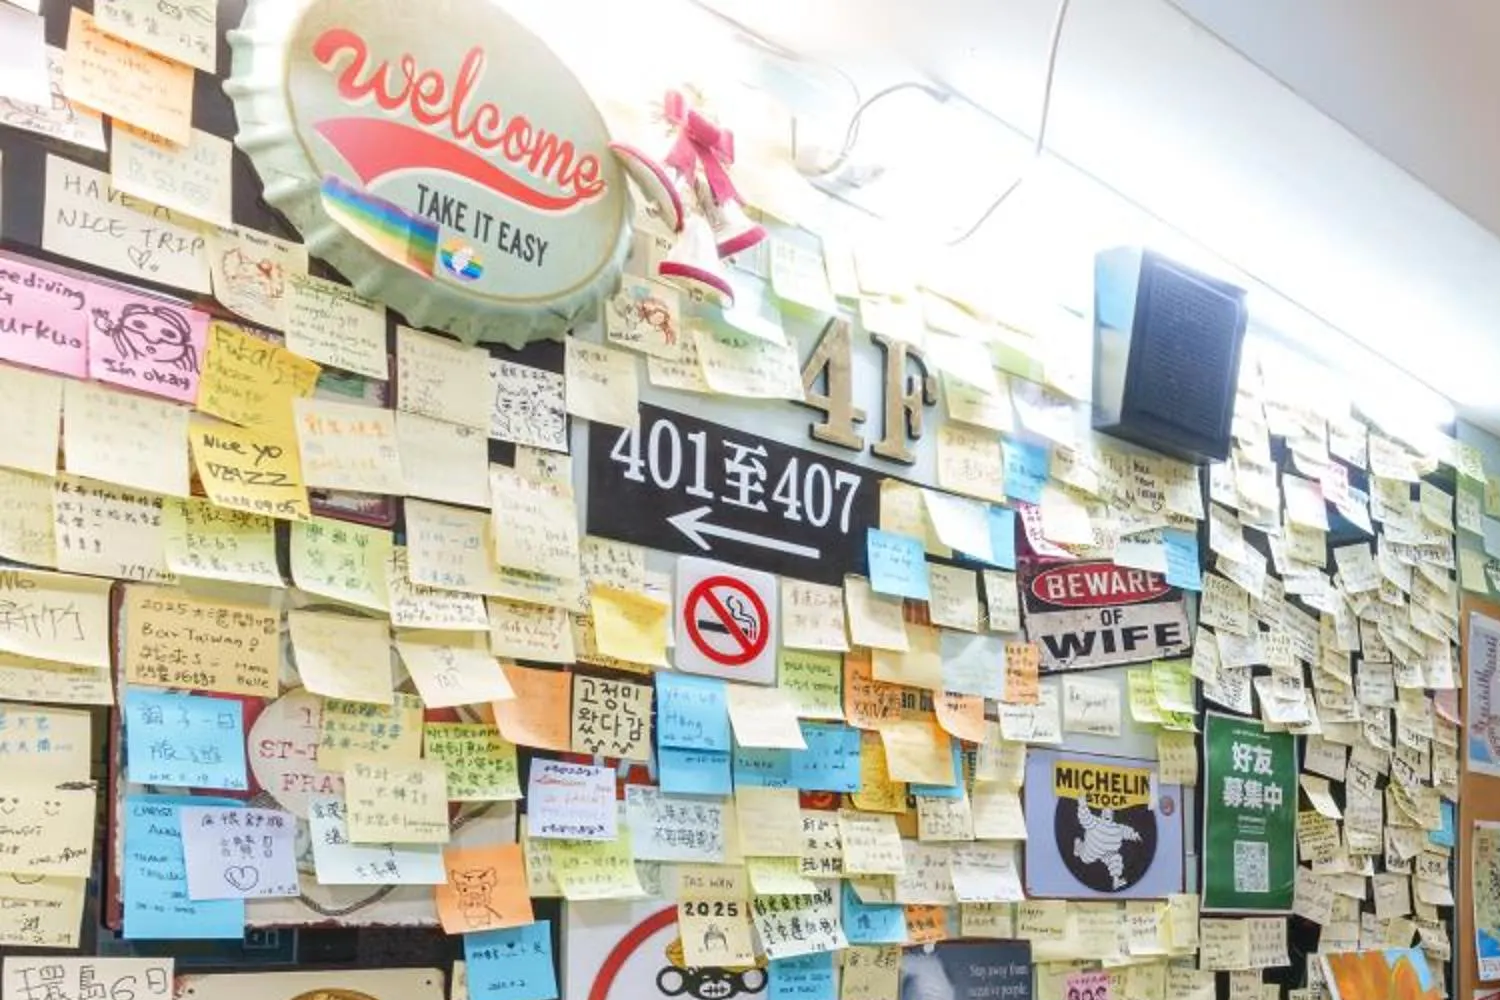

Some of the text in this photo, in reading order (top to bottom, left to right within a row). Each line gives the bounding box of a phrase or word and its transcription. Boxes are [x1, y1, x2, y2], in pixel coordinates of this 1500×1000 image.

[313, 28, 607, 198] welcome
[65, 175, 134, 208] HAVE
[57, 208, 126, 238] NICE
[142, 228, 206, 254] TRIP
[417, 184, 549, 268] TAKE IT EASY
[801, 315, 938, 467] 4F
[610, 417, 862, 534] 401至407
[1046, 570, 1162, 599] BEWARE
[1101, 608, 1124, 626] OF
[1043, 621, 1183, 660] WIFE
[580, 678, 640, 716] 고정민
[578, 706, 645, 742] 왔다감
[1231, 740, 1274, 777] 好友
[1056, 766, 1151, 797] MICHELIN
[1086, 792, 1128, 807] STOCK
[1222, 776, 1283, 812] 募集中
[684, 901, 739, 918] 2025
